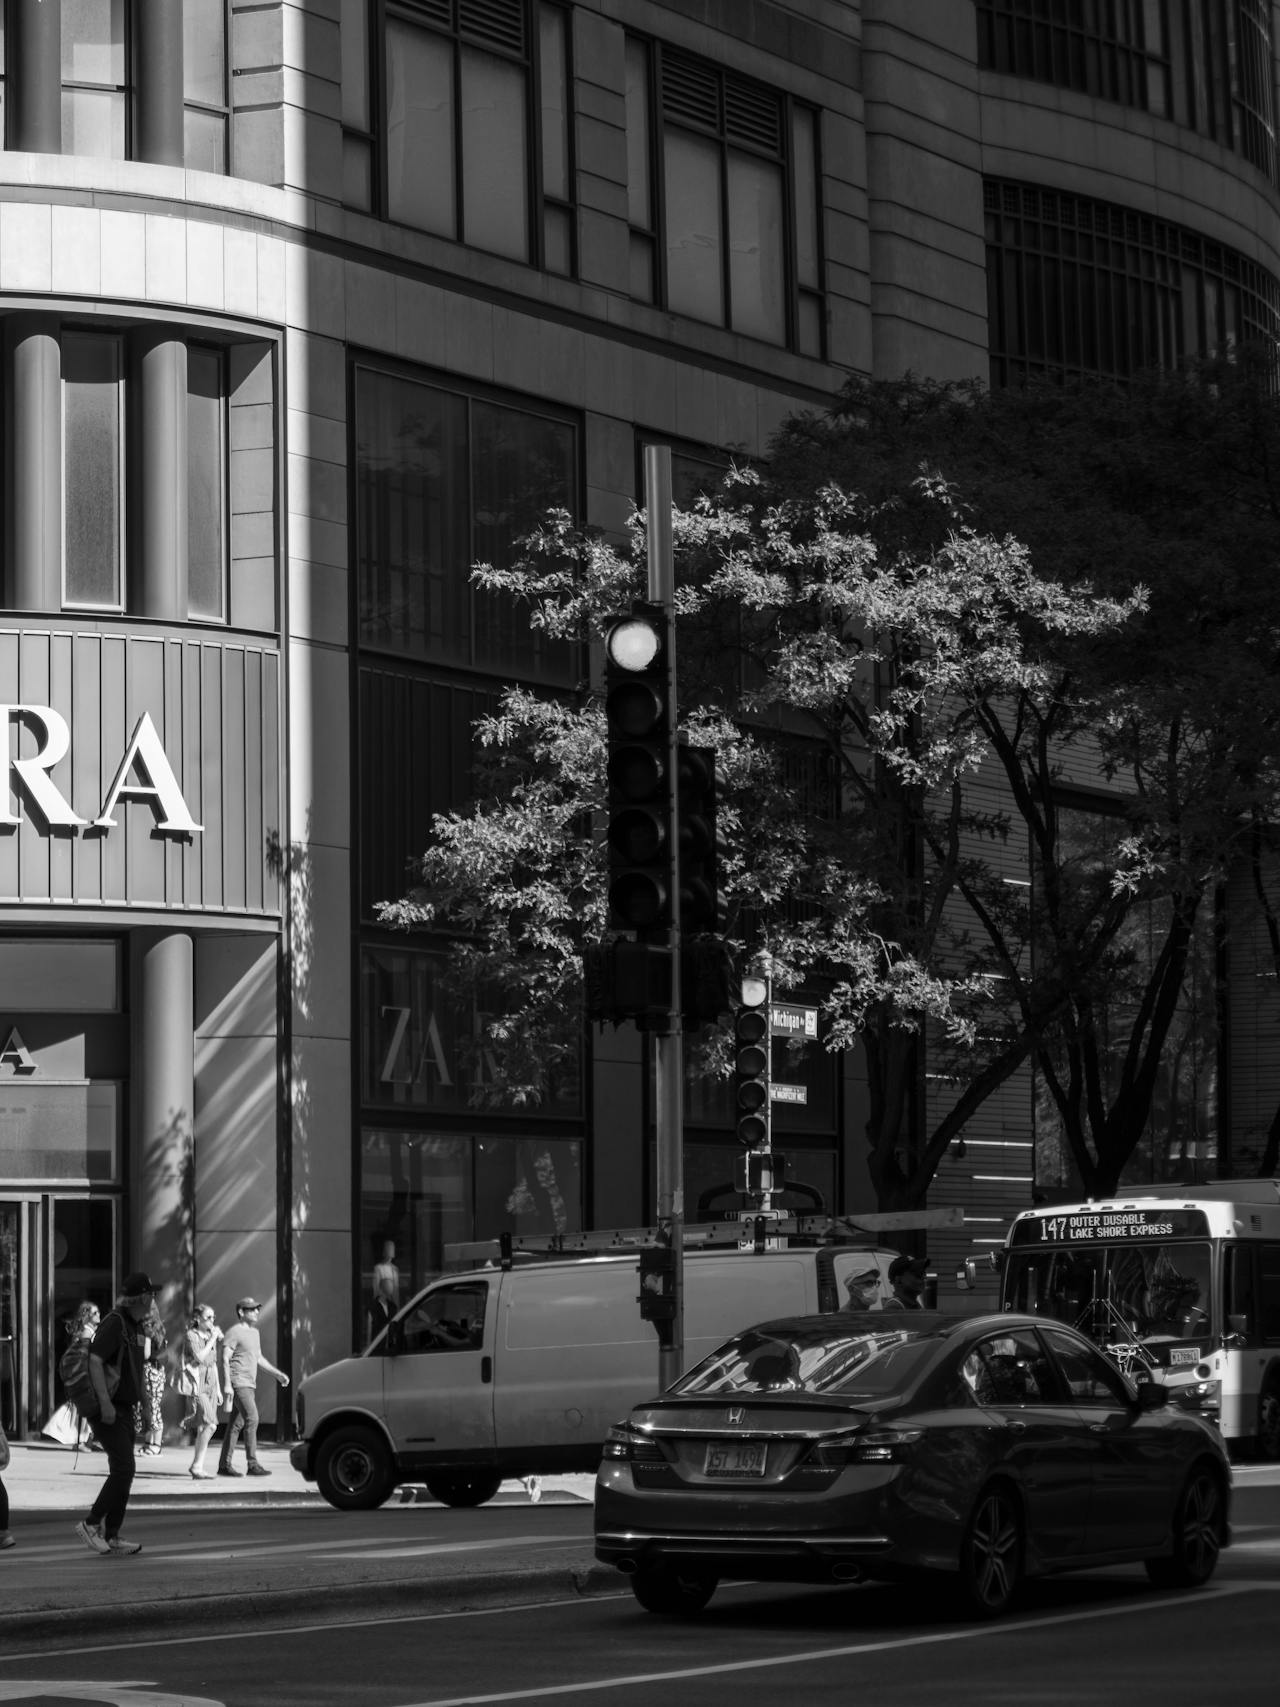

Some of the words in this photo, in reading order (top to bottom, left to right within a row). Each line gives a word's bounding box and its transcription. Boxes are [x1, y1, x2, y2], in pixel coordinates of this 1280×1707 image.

[773, 1009, 800, 1033] Michigan
[1040, 1217, 1067, 1240] 147
[1069, 1216, 1100, 1228] OUTER
[1103, 1213, 1146, 1226] DUSABLE
[1069, 1227, 1094, 1239] LAKE
[1096, 1225, 1127, 1238] SHORE
[1130, 1223, 1173, 1236] EXPRESS
